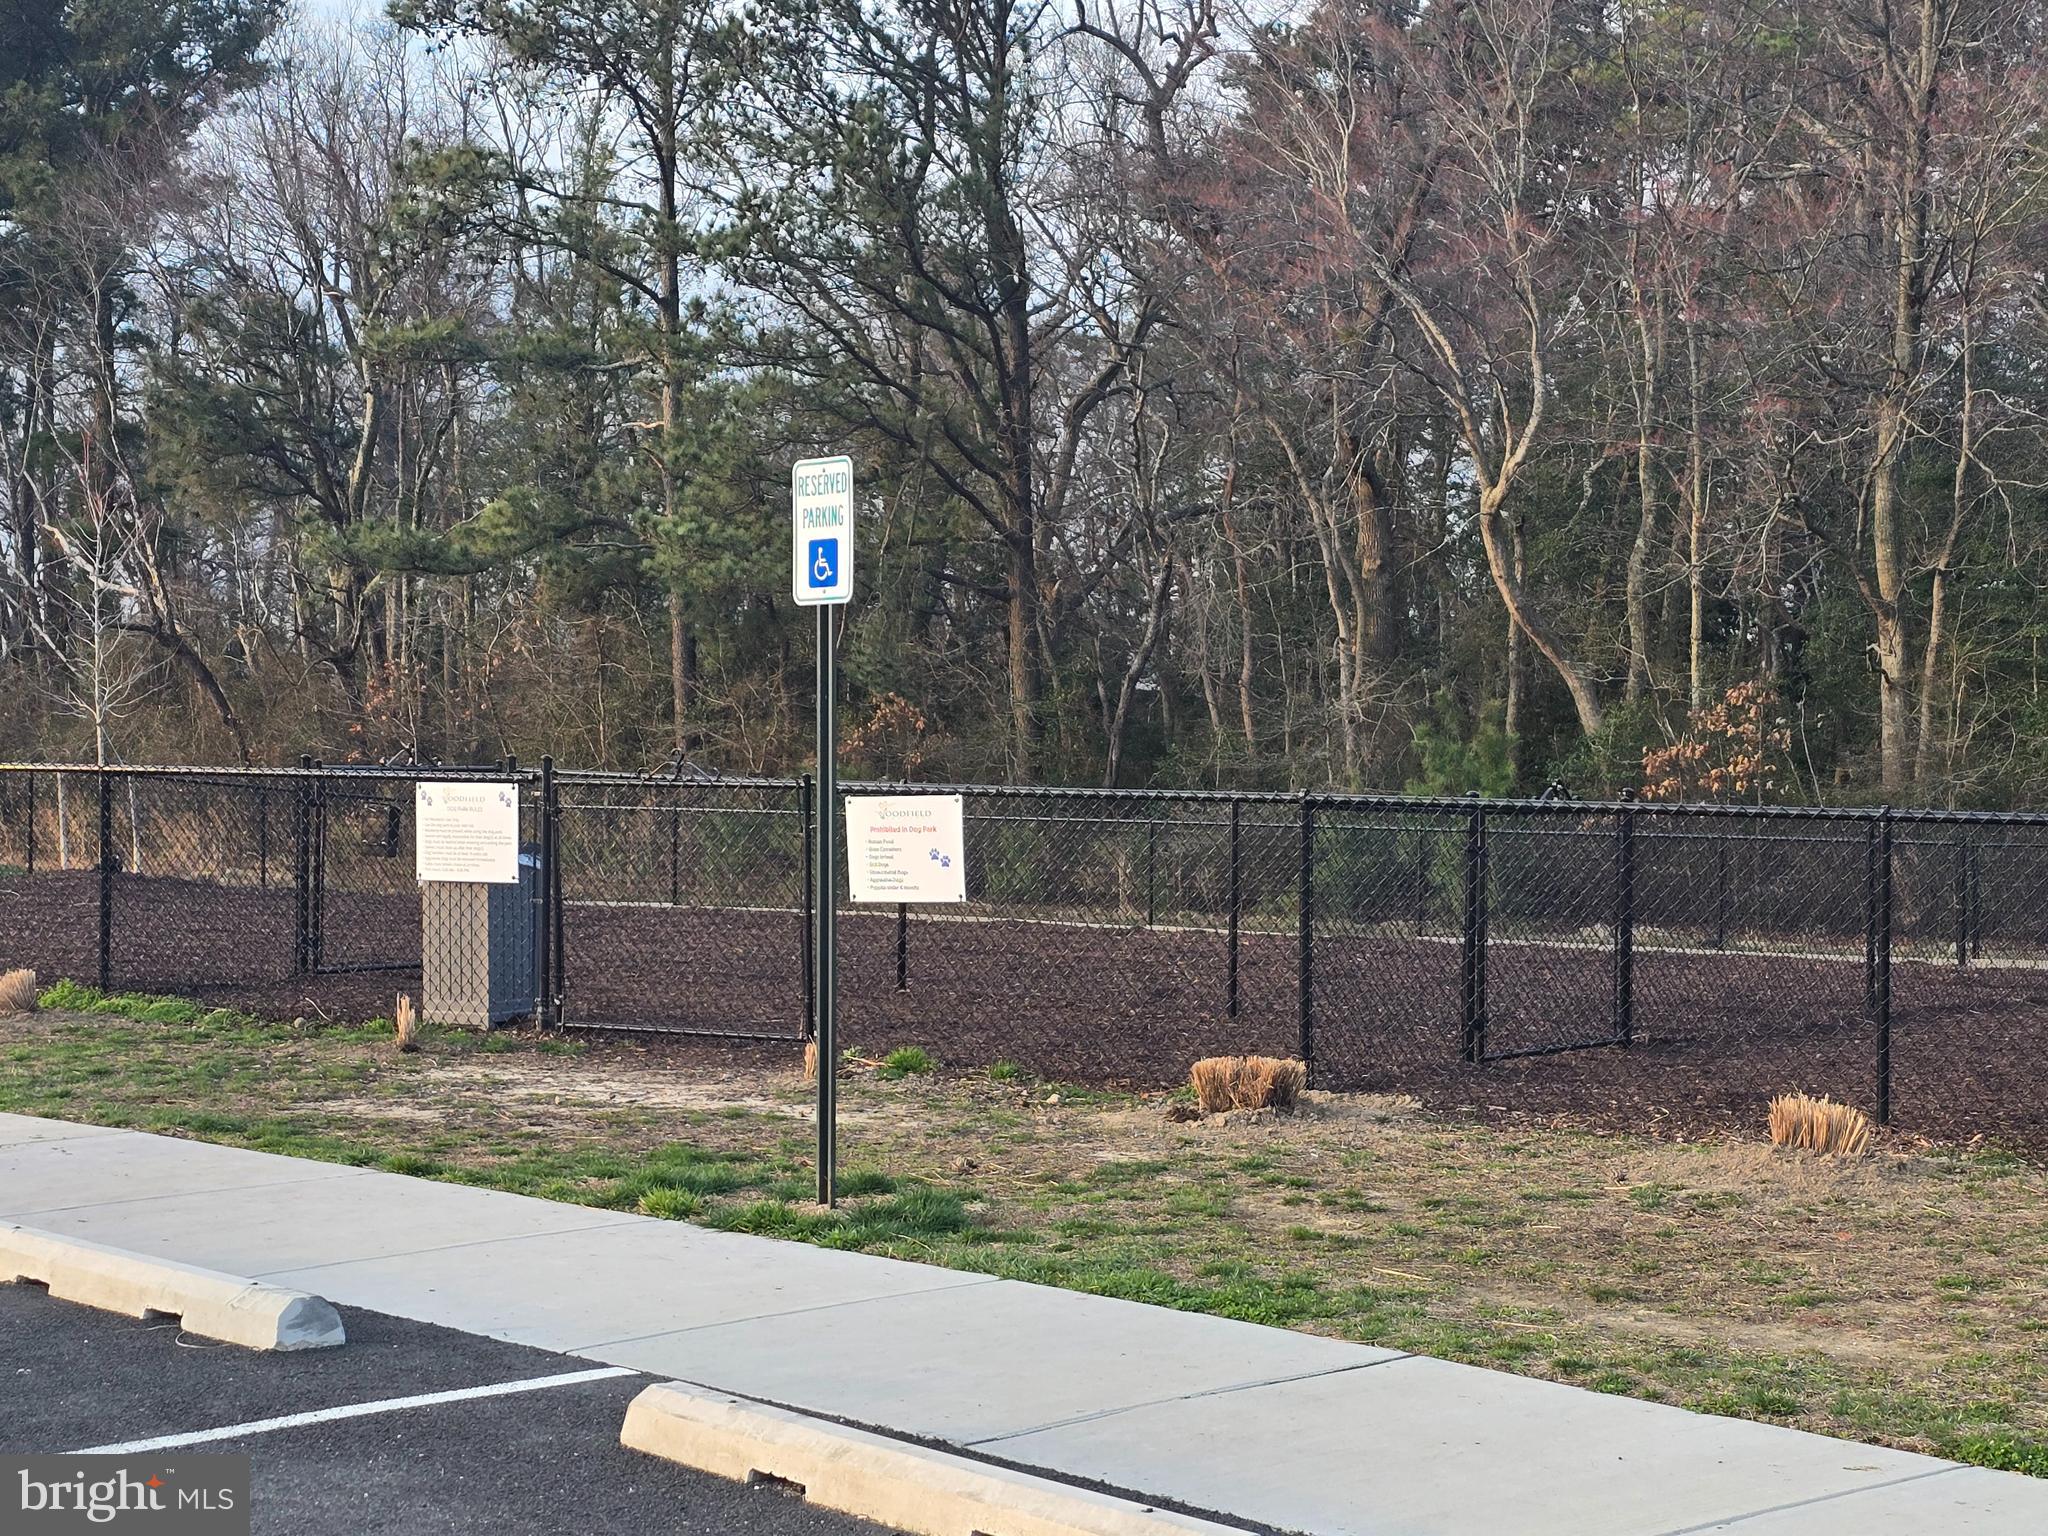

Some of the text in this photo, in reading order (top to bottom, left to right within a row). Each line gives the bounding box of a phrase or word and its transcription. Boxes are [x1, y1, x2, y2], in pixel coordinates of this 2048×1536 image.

[798, 472, 848, 497] RESERVED
[803, 505, 844, 528] PARKING
[923, 825, 937, 833] Park
